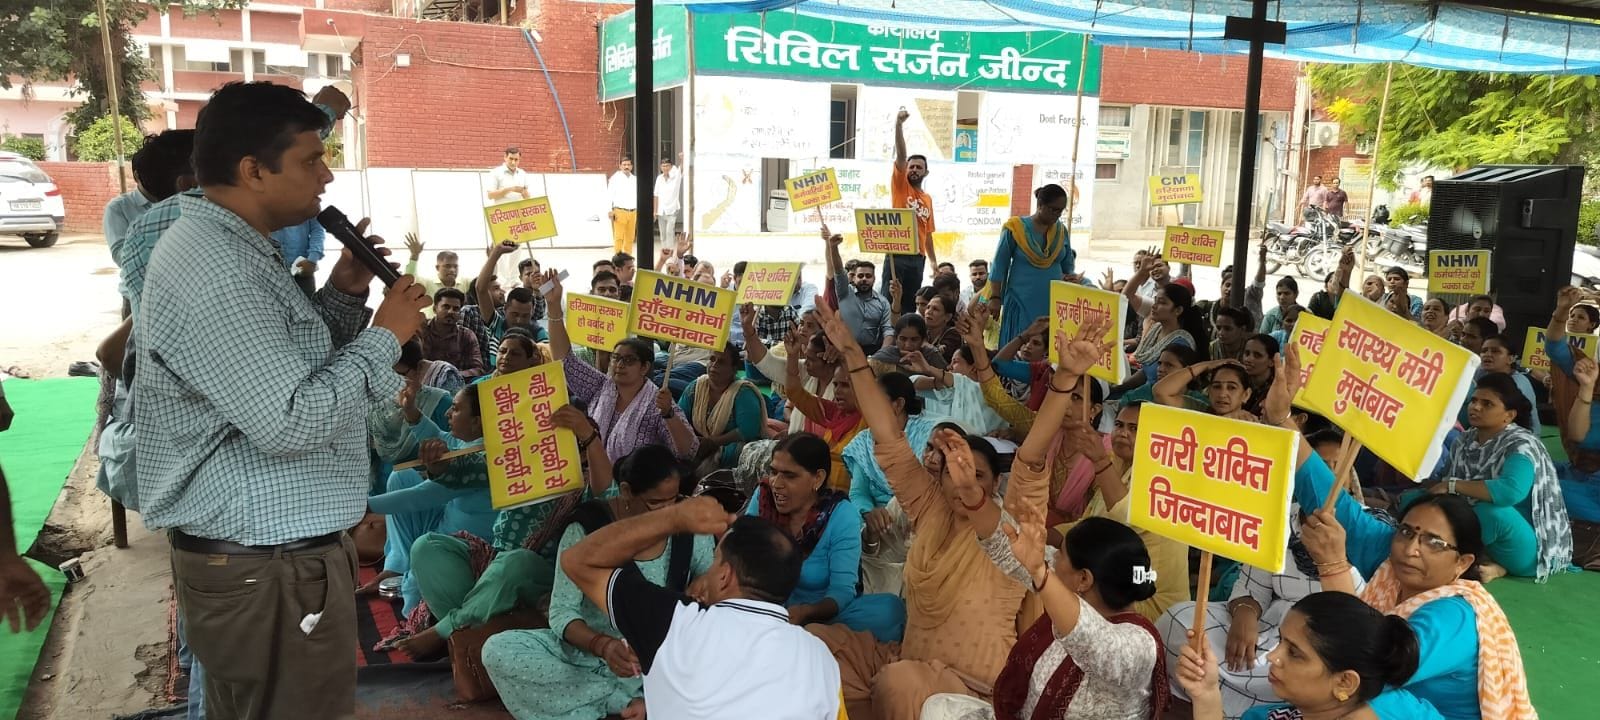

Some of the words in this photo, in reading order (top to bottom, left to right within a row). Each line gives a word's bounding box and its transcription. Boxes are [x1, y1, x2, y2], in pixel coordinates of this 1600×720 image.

[724, 25, 861, 70] सिविल
[869, 42, 972, 78] सर्जन
[977, 47, 1071, 88] जीन्द
[793, 172, 828, 190] NHM
[1161, 176, 1186, 185] CM
[490, 209, 519, 224] हरियाणा
[520, 203, 547, 217] सरकार
[864, 212, 902, 225] NHM
[509, 220, 536, 240] मुर्दाबाद
[887, 227, 911, 239] मोर्चा
[864, 239, 910, 251] जिन्दाबाद
[1170, 232, 1189, 245] नारी
[1192, 234, 1217, 248] शक्ति
[1170, 246, 1214, 263] जिन्दाबाद
[1437, 254, 1478, 268] NHM
[747, 268, 767, 282] नारी
[767, 268, 793, 282] शक्ति
[1471, 269, 1481, 279] को
[654, 278, 718, 308] NHM
[743, 286, 784, 300] जिन्दाबाद
[568, 298, 597, 313] हरियाणा
[598, 305, 623, 318] सरकार
[577, 315, 586, 327] हो
[587, 317, 605, 330] बर्बाद
[607, 320, 616, 332] हो
[685, 309, 726, 330] मोर्चा
[587, 332, 605, 345] बर्बाद
[638, 314, 718, 346] जिन्दाबाद
[1536, 331, 1586, 350] NM
[1338, 320, 1401, 373] स्वास्थ्य
[1397, 349, 1444, 396] मंत्री
[1334, 370, 1404, 429] मुर्दाबाद
[498, 416, 525, 444] लेंगे
[494, 445, 532, 479] कुर्सी
[1149, 426, 1198, 473] नारी
[1203, 437, 1273, 492] शक्ति
[508, 480, 533, 496] से
[545, 474, 570, 490] से
[1149, 476, 1262, 550] जिन्दाबाद
